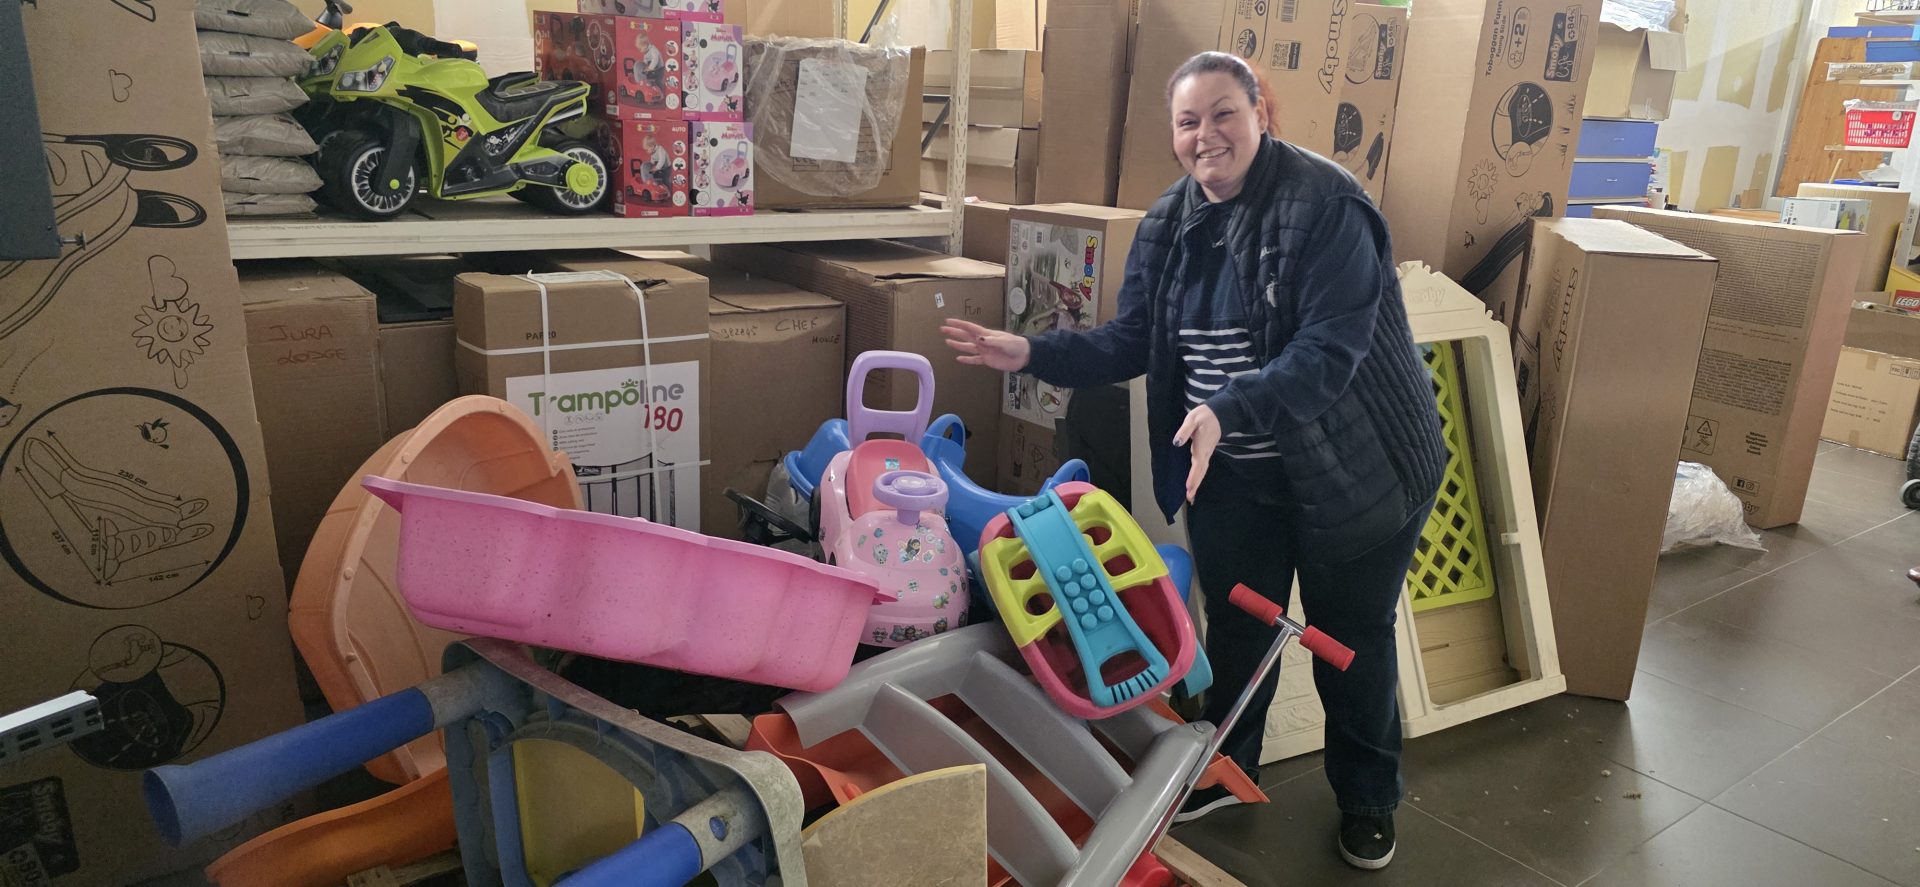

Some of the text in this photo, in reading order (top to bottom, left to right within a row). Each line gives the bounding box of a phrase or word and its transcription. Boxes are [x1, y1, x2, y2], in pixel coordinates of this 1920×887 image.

[664, 25, 679, 33] AUTO
[1318, 0, 1348, 94] Smoby
[1485, 28, 1499, 76] Toboggan
[1546, 33, 1565, 79] Smoby
[671, 125, 687, 133] AUTO
[1079, 235, 1099, 302] Smoby
[1895, 296, 1920, 307] LEGO
[775, 316, 819, 334] CHEF
[1553, 268, 1578, 373] Smoby
[267, 324, 334, 343] JURA
[644, 404, 684, 433] 180
[118, 469, 147, 486] 230 cm
